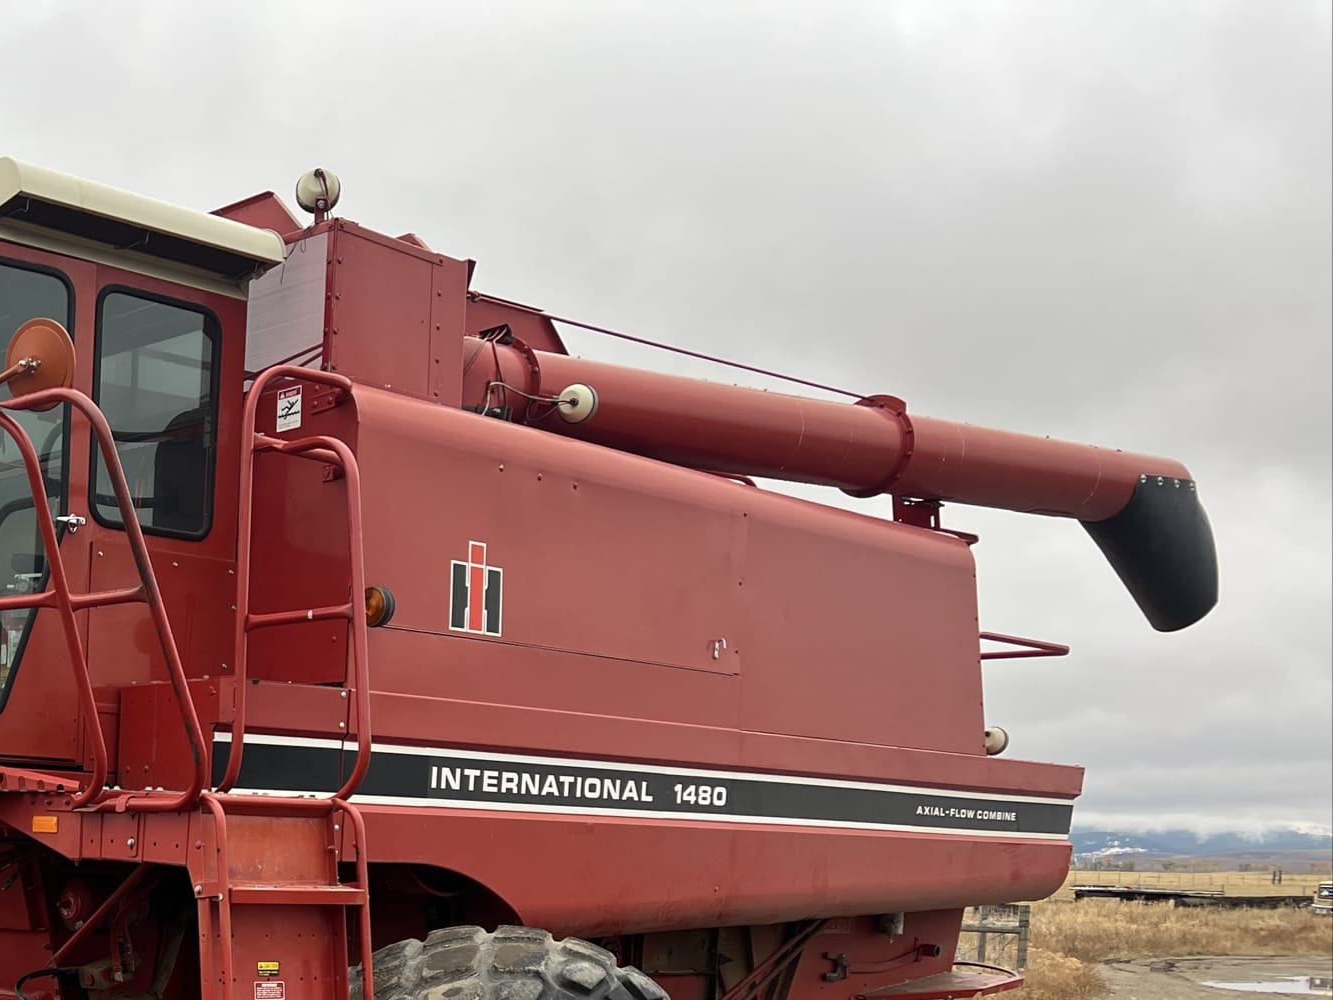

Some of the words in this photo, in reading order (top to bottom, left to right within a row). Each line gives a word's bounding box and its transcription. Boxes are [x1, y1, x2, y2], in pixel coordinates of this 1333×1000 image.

[430, 766, 654, 802] INTERNATIONAL
[674, 783, 728, 807] 1480
[915, 805, 976, 819] AXIAL-FLOW
[976, 810, 1017, 821] COMBINE
